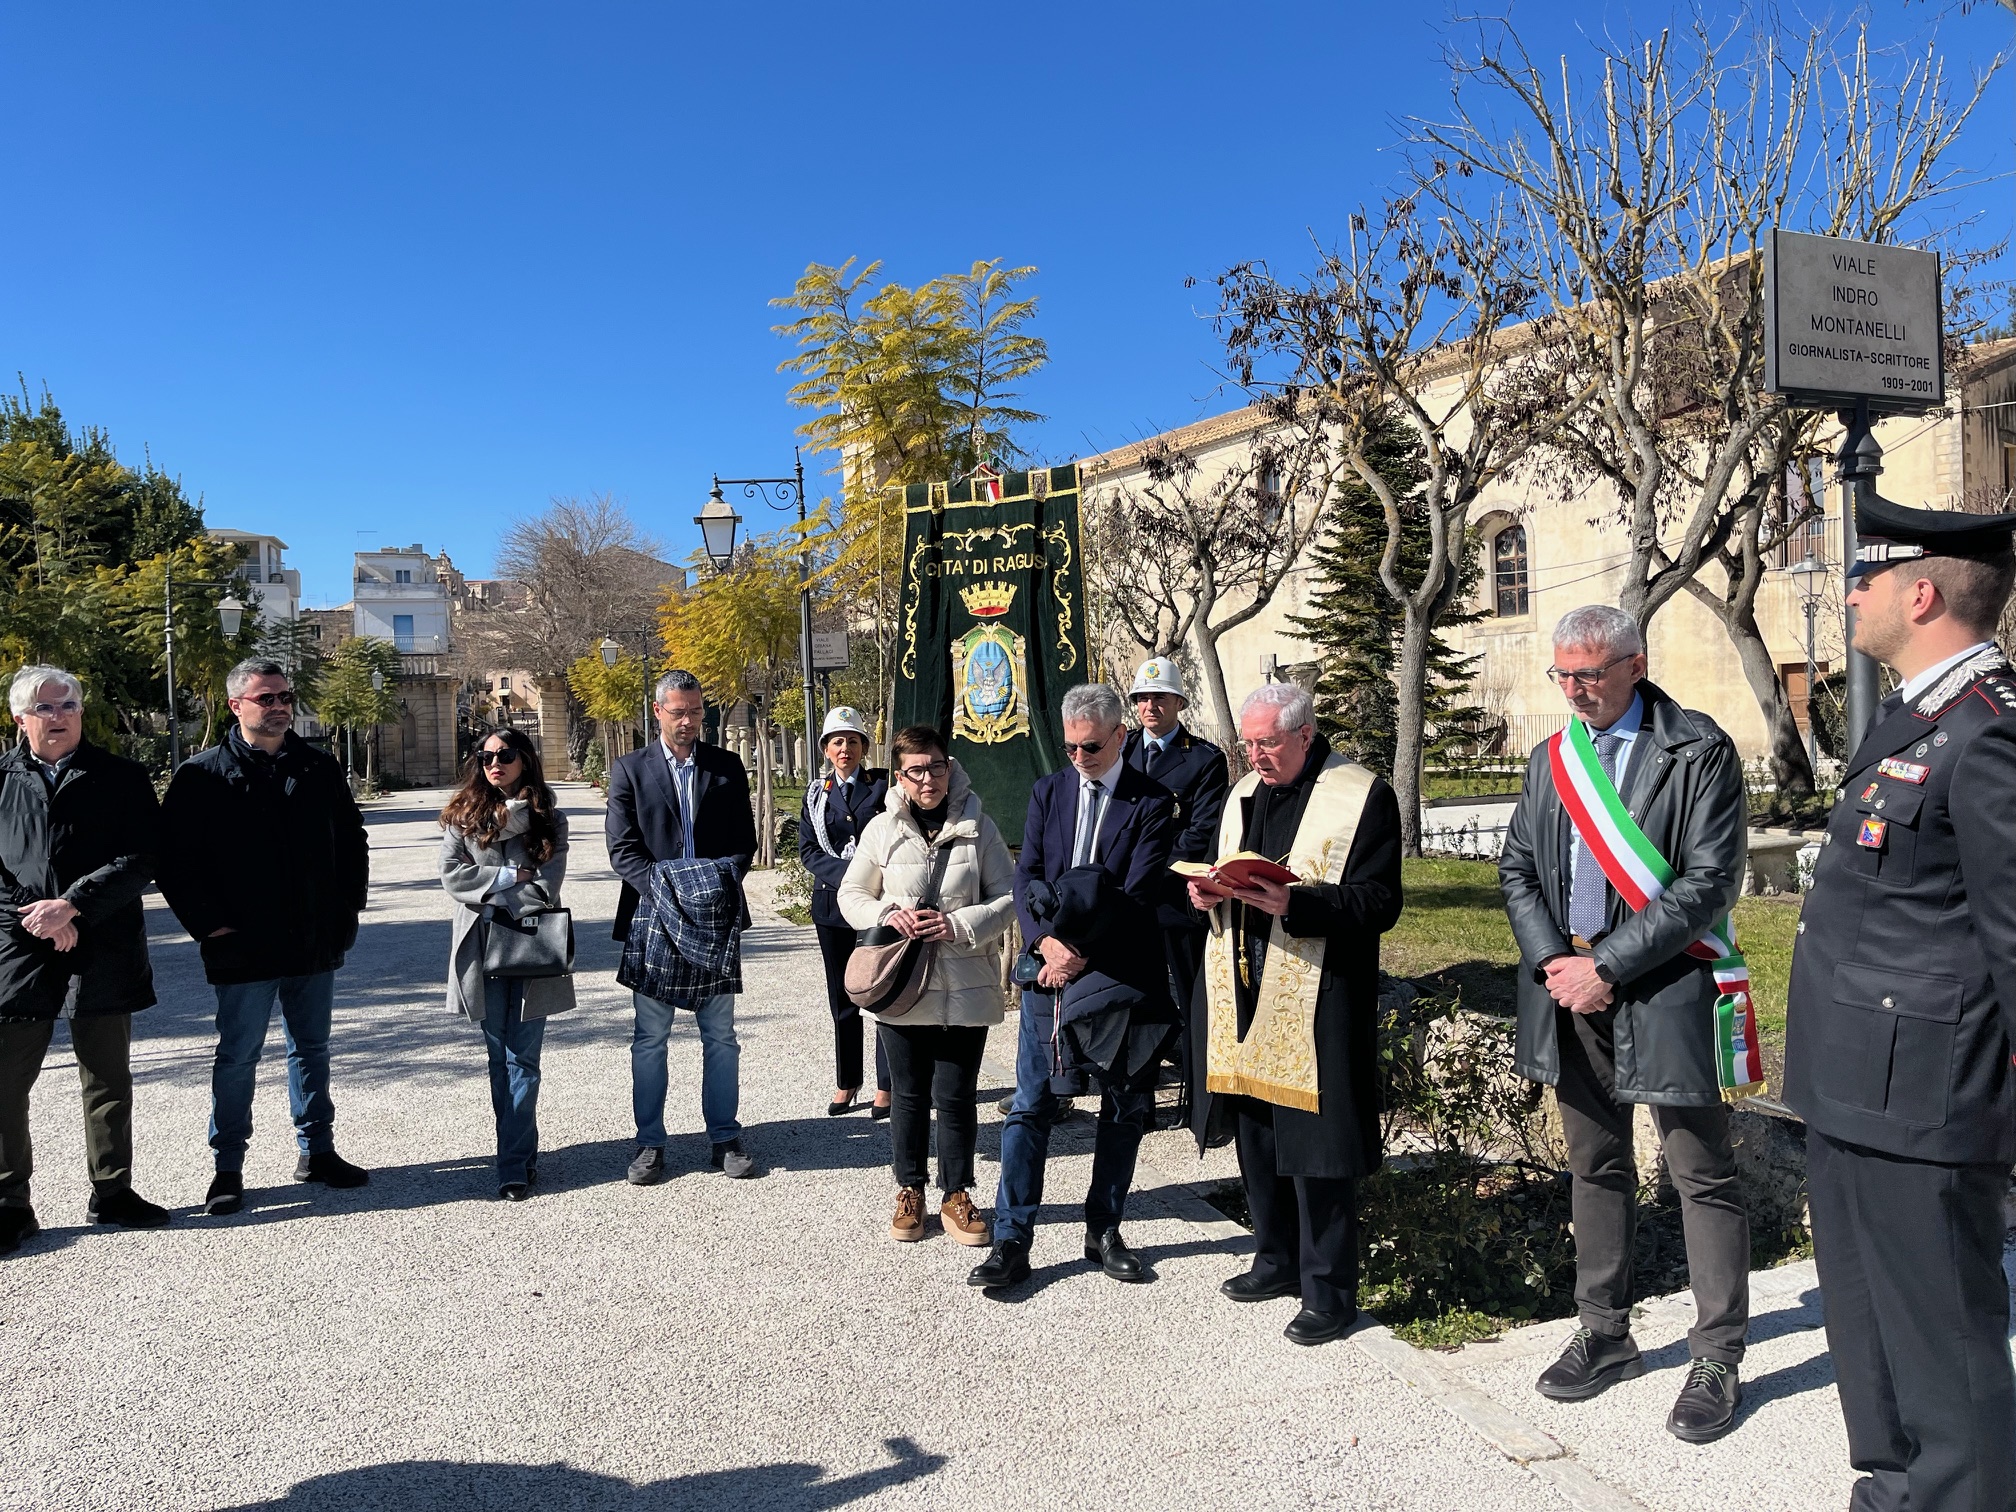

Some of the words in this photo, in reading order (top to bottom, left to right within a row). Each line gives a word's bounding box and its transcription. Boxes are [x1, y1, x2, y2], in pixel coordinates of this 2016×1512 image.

[1832, 253, 1876, 276] VIALE
[1833, 285, 1878, 306] INDRO
[1811, 314, 1906, 341] MONTANELLI
[1789, 343, 1930, 370] GIORNALISTA-SCRITTORE
[1881, 376, 1933, 393] 1909-2001
[925, 559, 969, 578] CITA'
[972, 559, 988, 575] DI
[993, 553, 1048, 574] RAGUS
